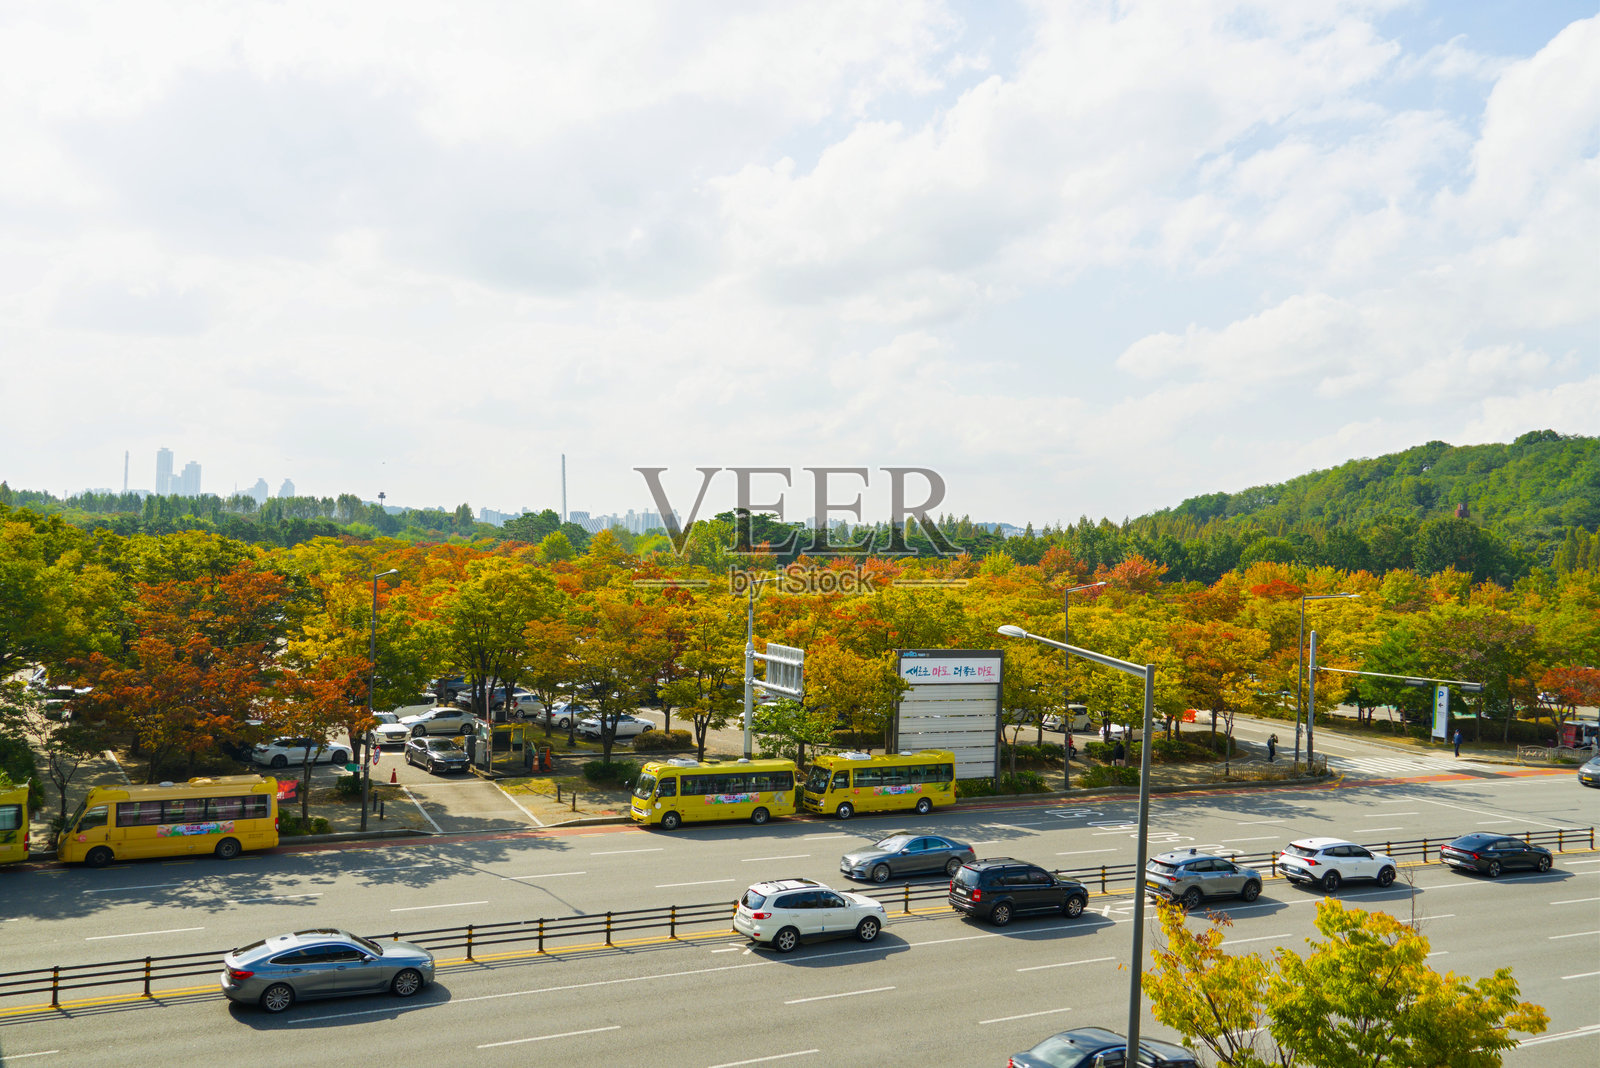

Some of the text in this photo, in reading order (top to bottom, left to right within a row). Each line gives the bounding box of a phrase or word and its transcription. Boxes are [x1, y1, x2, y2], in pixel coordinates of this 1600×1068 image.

[905, 665, 930, 677] 새로운
[932, 665, 951, 677] 마포
[953, 665, 962, 677] 더
[977, 665, 995, 677] 마포
[1438, 690, 1444, 698] P
